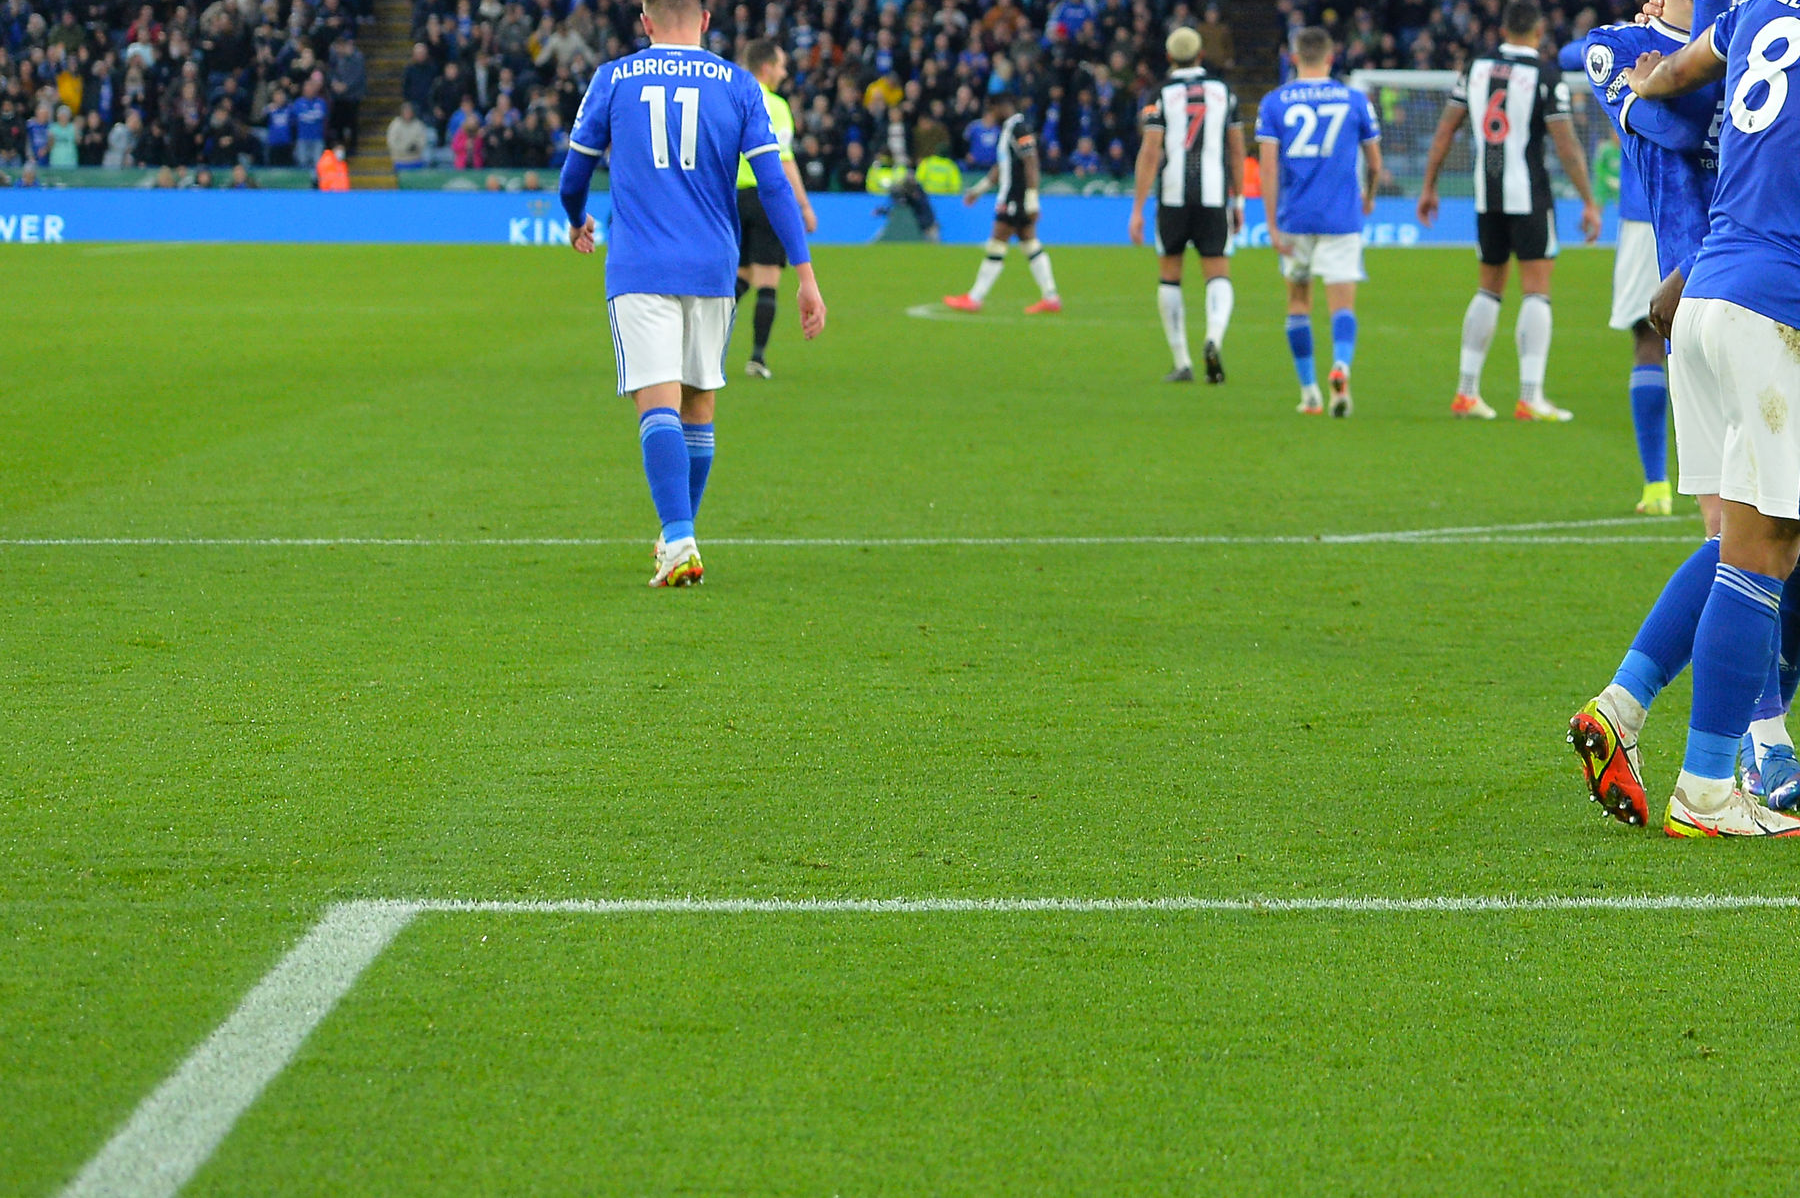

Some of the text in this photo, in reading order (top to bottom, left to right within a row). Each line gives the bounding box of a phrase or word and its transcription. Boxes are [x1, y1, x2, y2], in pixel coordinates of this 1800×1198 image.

[611, 59, 733, 85] ALBRIGHTON
[640, 85, 700, 170] 11
[1184, 102, 1206, 151] 7
[1284, 103, 1349, 158] 27
[1482, 88, 1509, 145] 6
